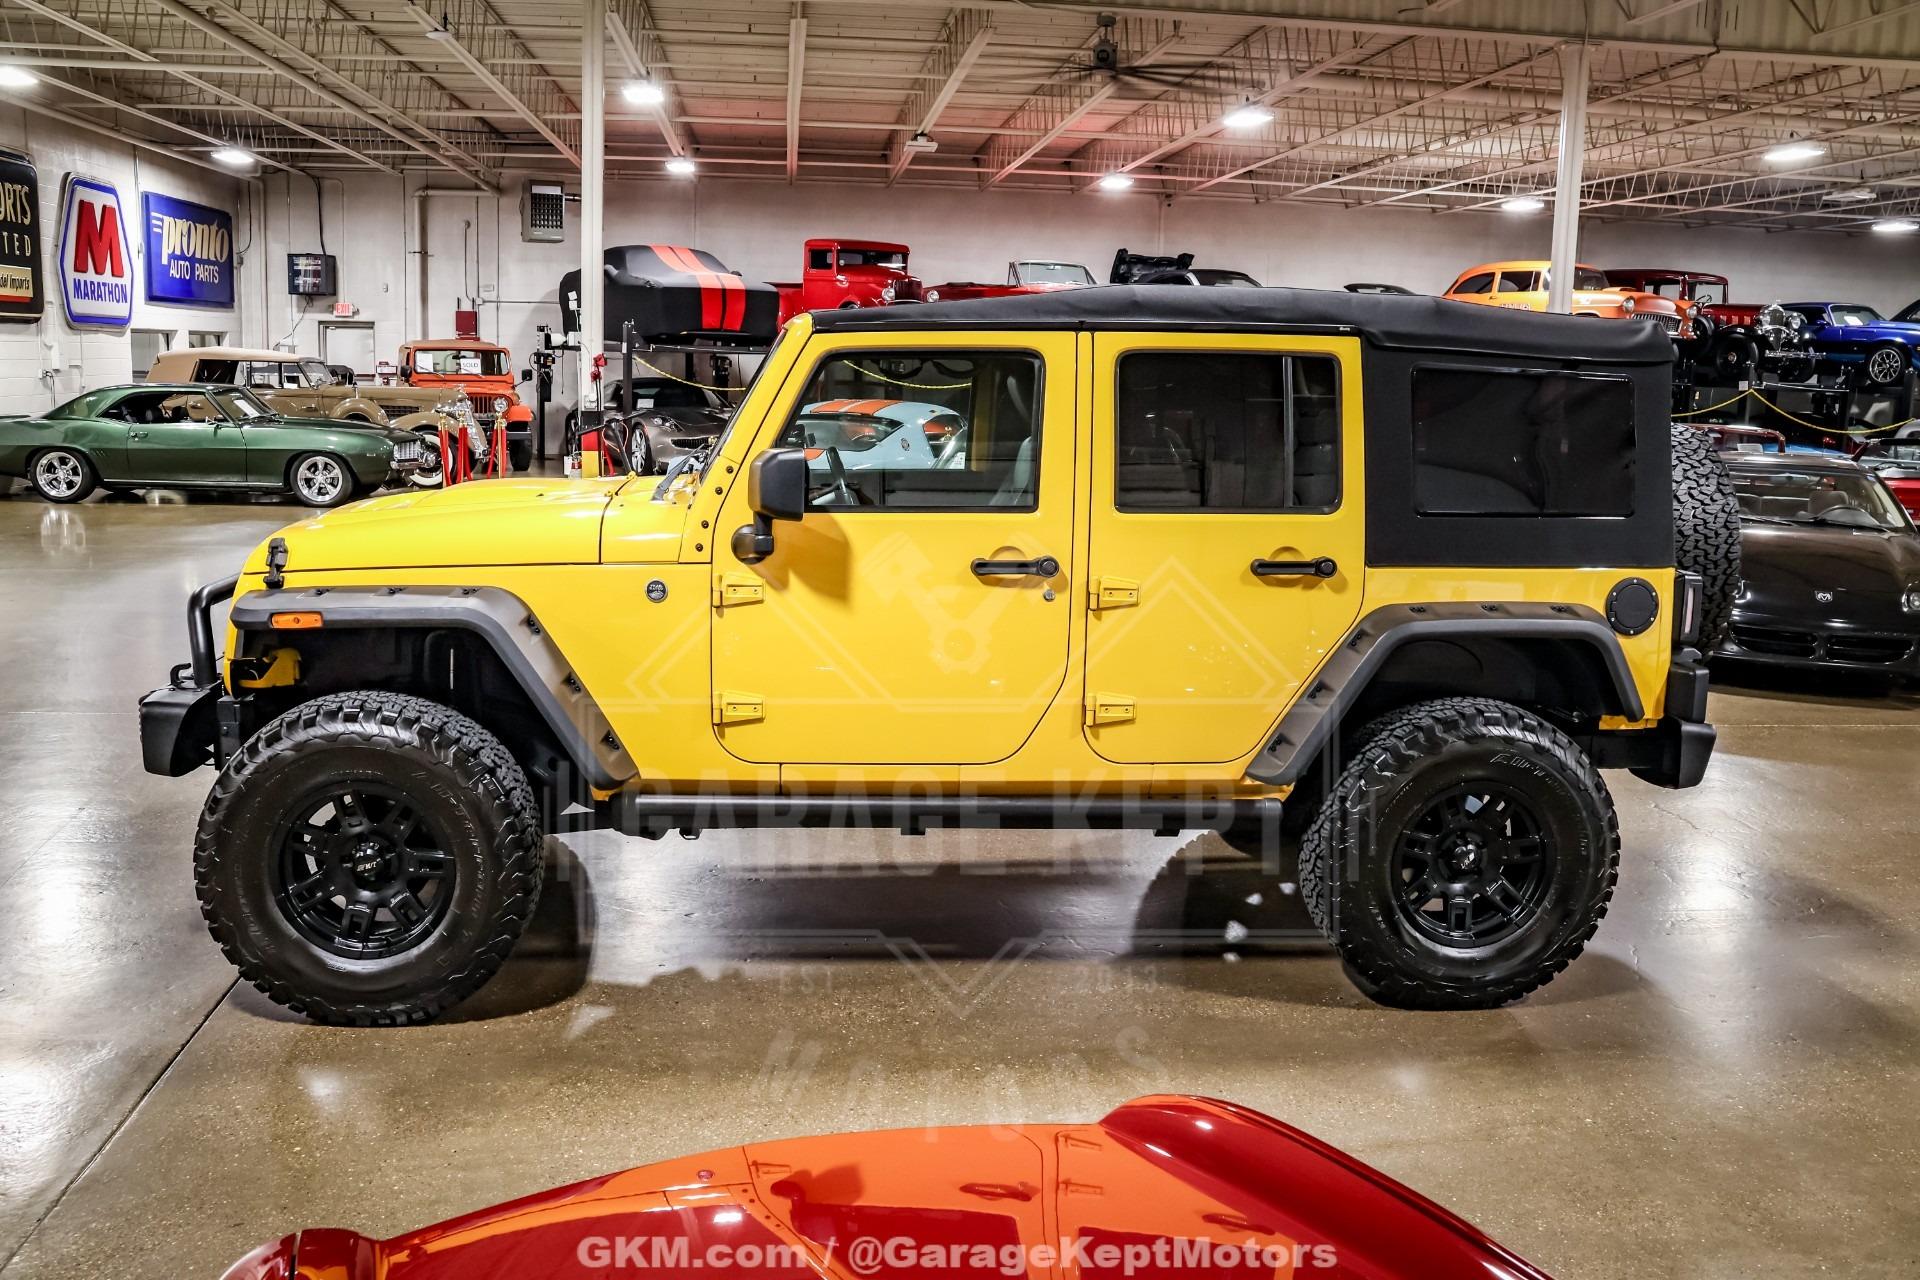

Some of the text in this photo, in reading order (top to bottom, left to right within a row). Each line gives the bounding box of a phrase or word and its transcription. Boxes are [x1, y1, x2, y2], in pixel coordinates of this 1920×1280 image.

[74, 199, 124, 277] M
[161, 215, 229, 263] pronto
[9, 274, 30, 291] Imports
[170, 259, 219, 284] AUTO PARTS
[73, 278, 128, 303] MARATHON
[336, 303, 350, 314] EXIT
